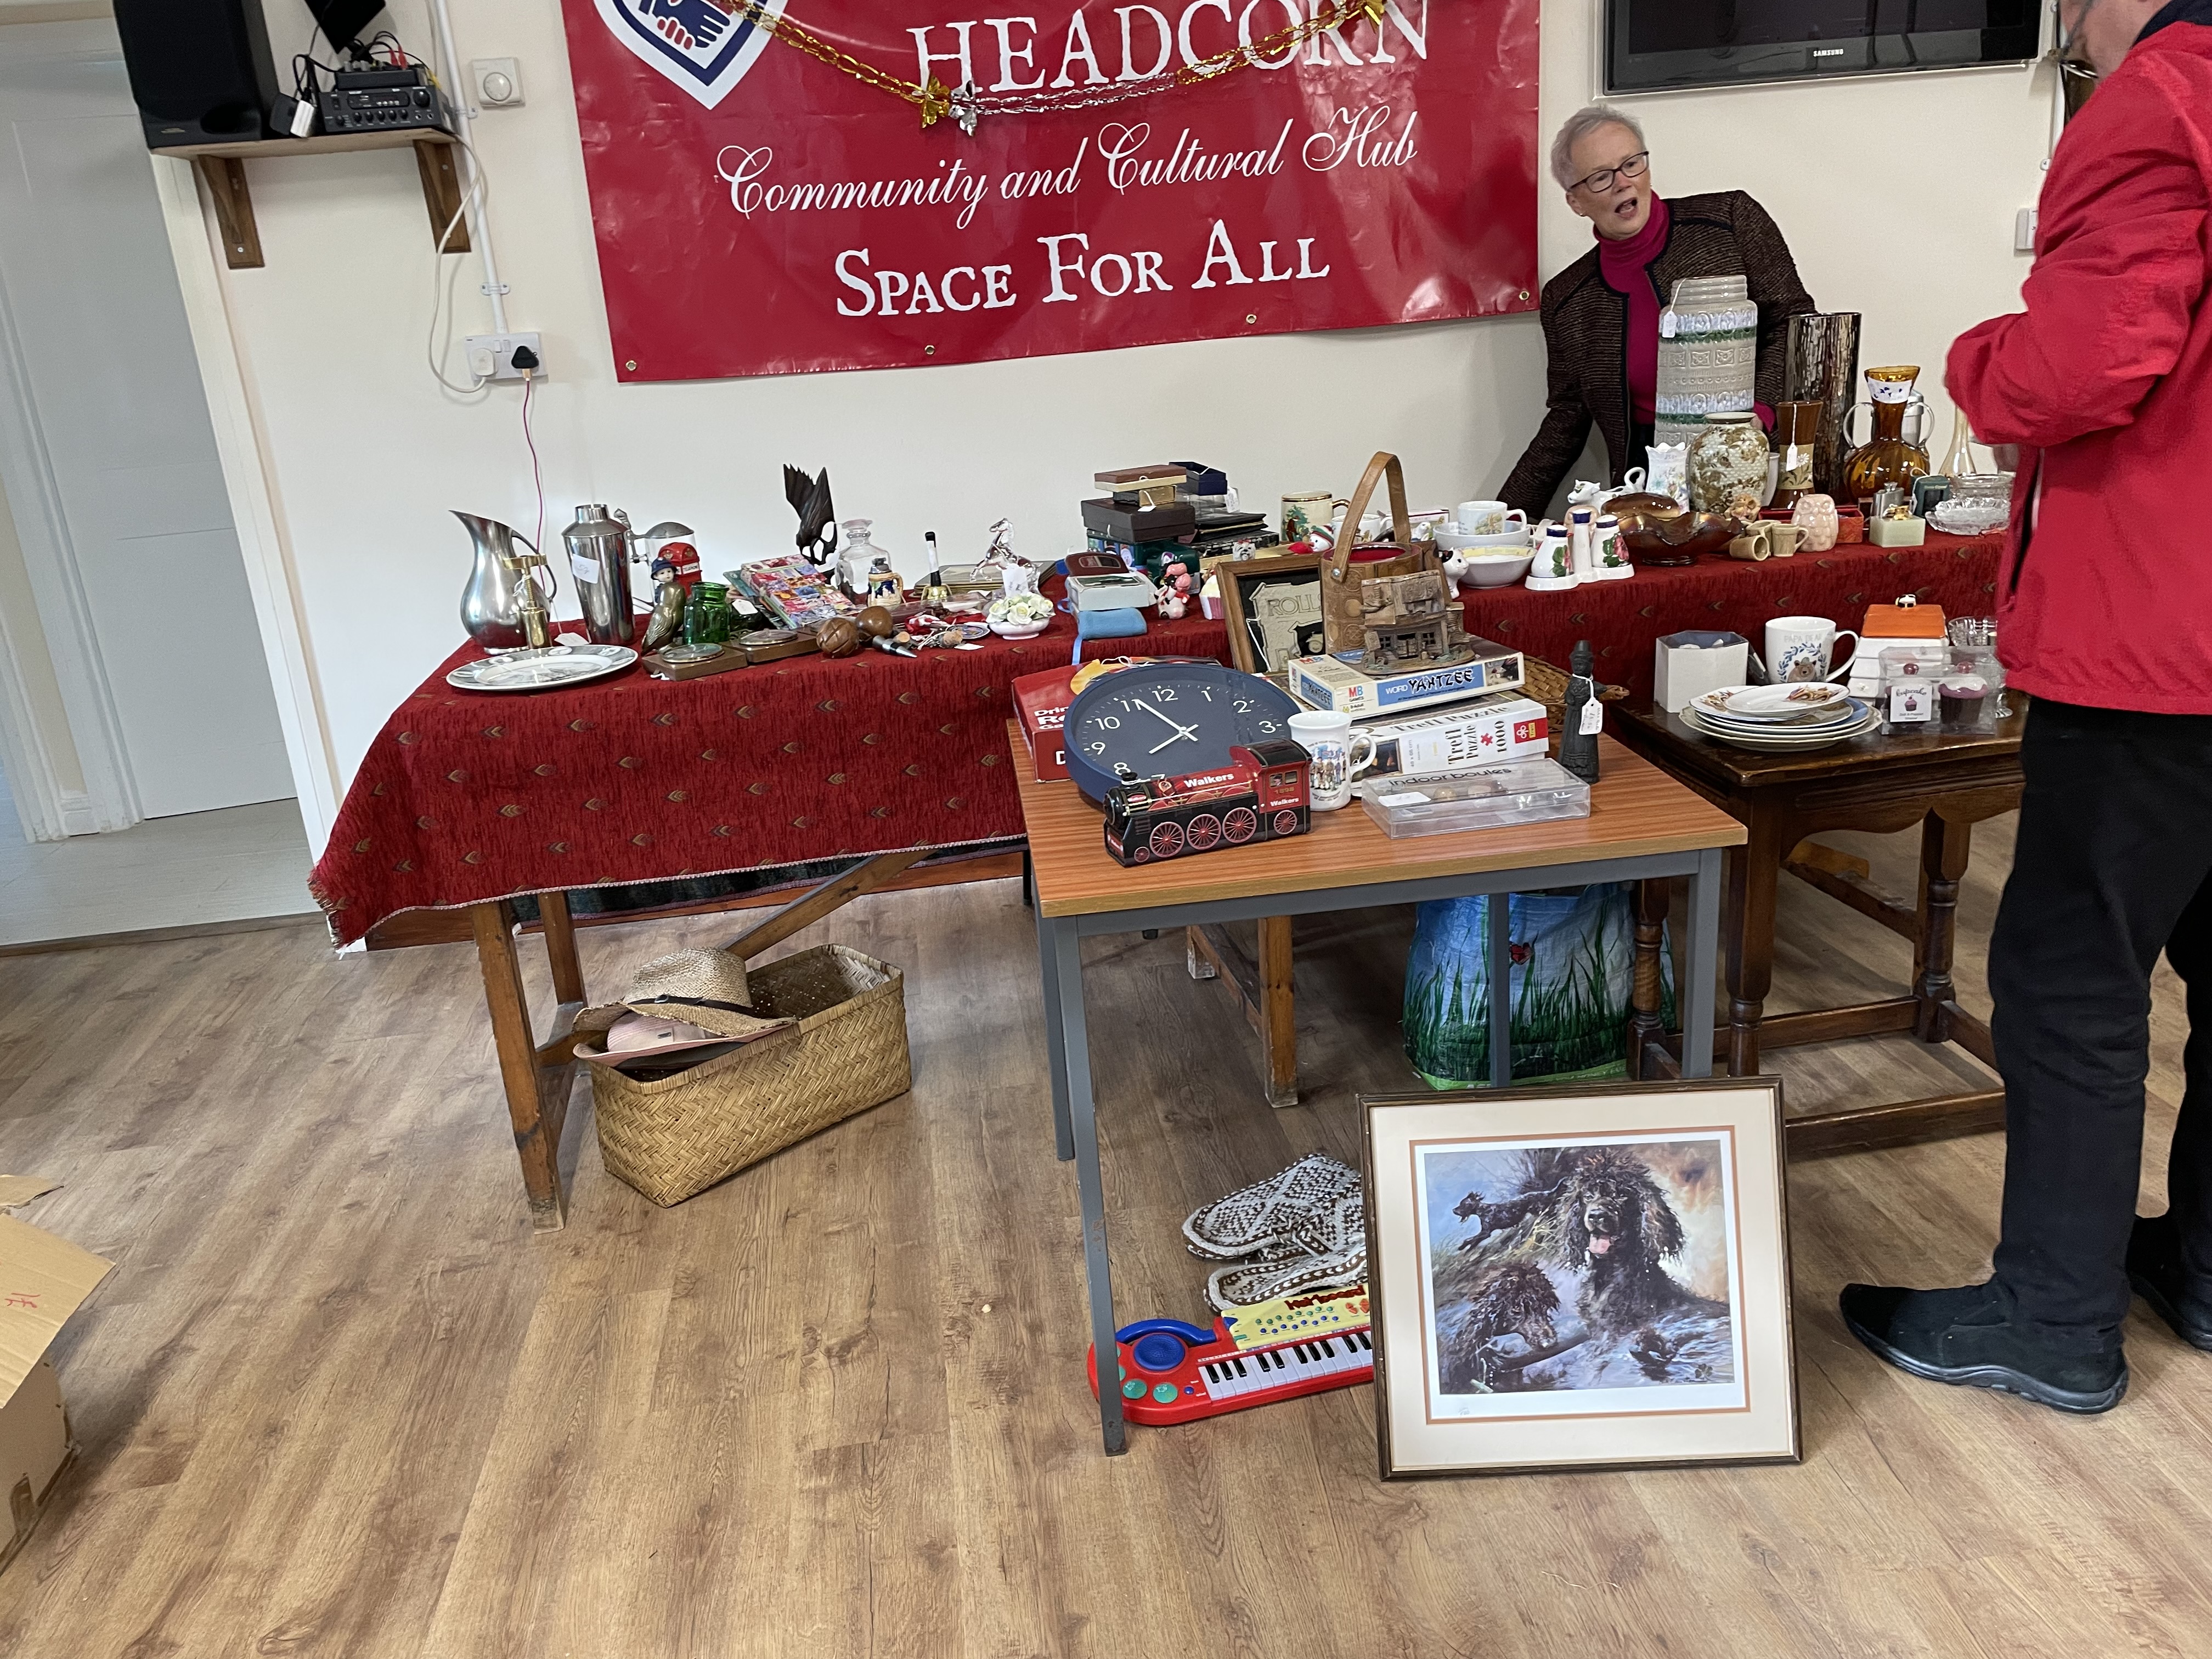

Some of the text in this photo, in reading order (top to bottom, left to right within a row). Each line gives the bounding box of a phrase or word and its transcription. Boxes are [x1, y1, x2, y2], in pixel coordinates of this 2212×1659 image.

[906, 0, 1427, 94] HEADCORN
[716, 105, 1418, 229] Community and Cultural Hub
[1385, 684, 1408, 695] WORD
[1408, 668, 1475, 695] YAHTZEE
[1152, 689, 1178, 702] 12
[1201, 690, 1212, 702] 1
[1348, 685, 1364, 697] MB
[1233, 700, 1252, 713] 2
[1095, 716, 1120, 730] 10
[1259, 720, 1276, 733] 3
[1464, 723, 1479, 759] Puzzle
[1494, 720, 1508, 753] 1000
[1091, 742, 1106, 755] 9
[1444, 728, 1465, 765] Trefl
[1184, 772, 1234, 788] Walkers
[1388, 768, 1513, 786] indoor boules
[1270, 797, 1299, 806] Walkers
